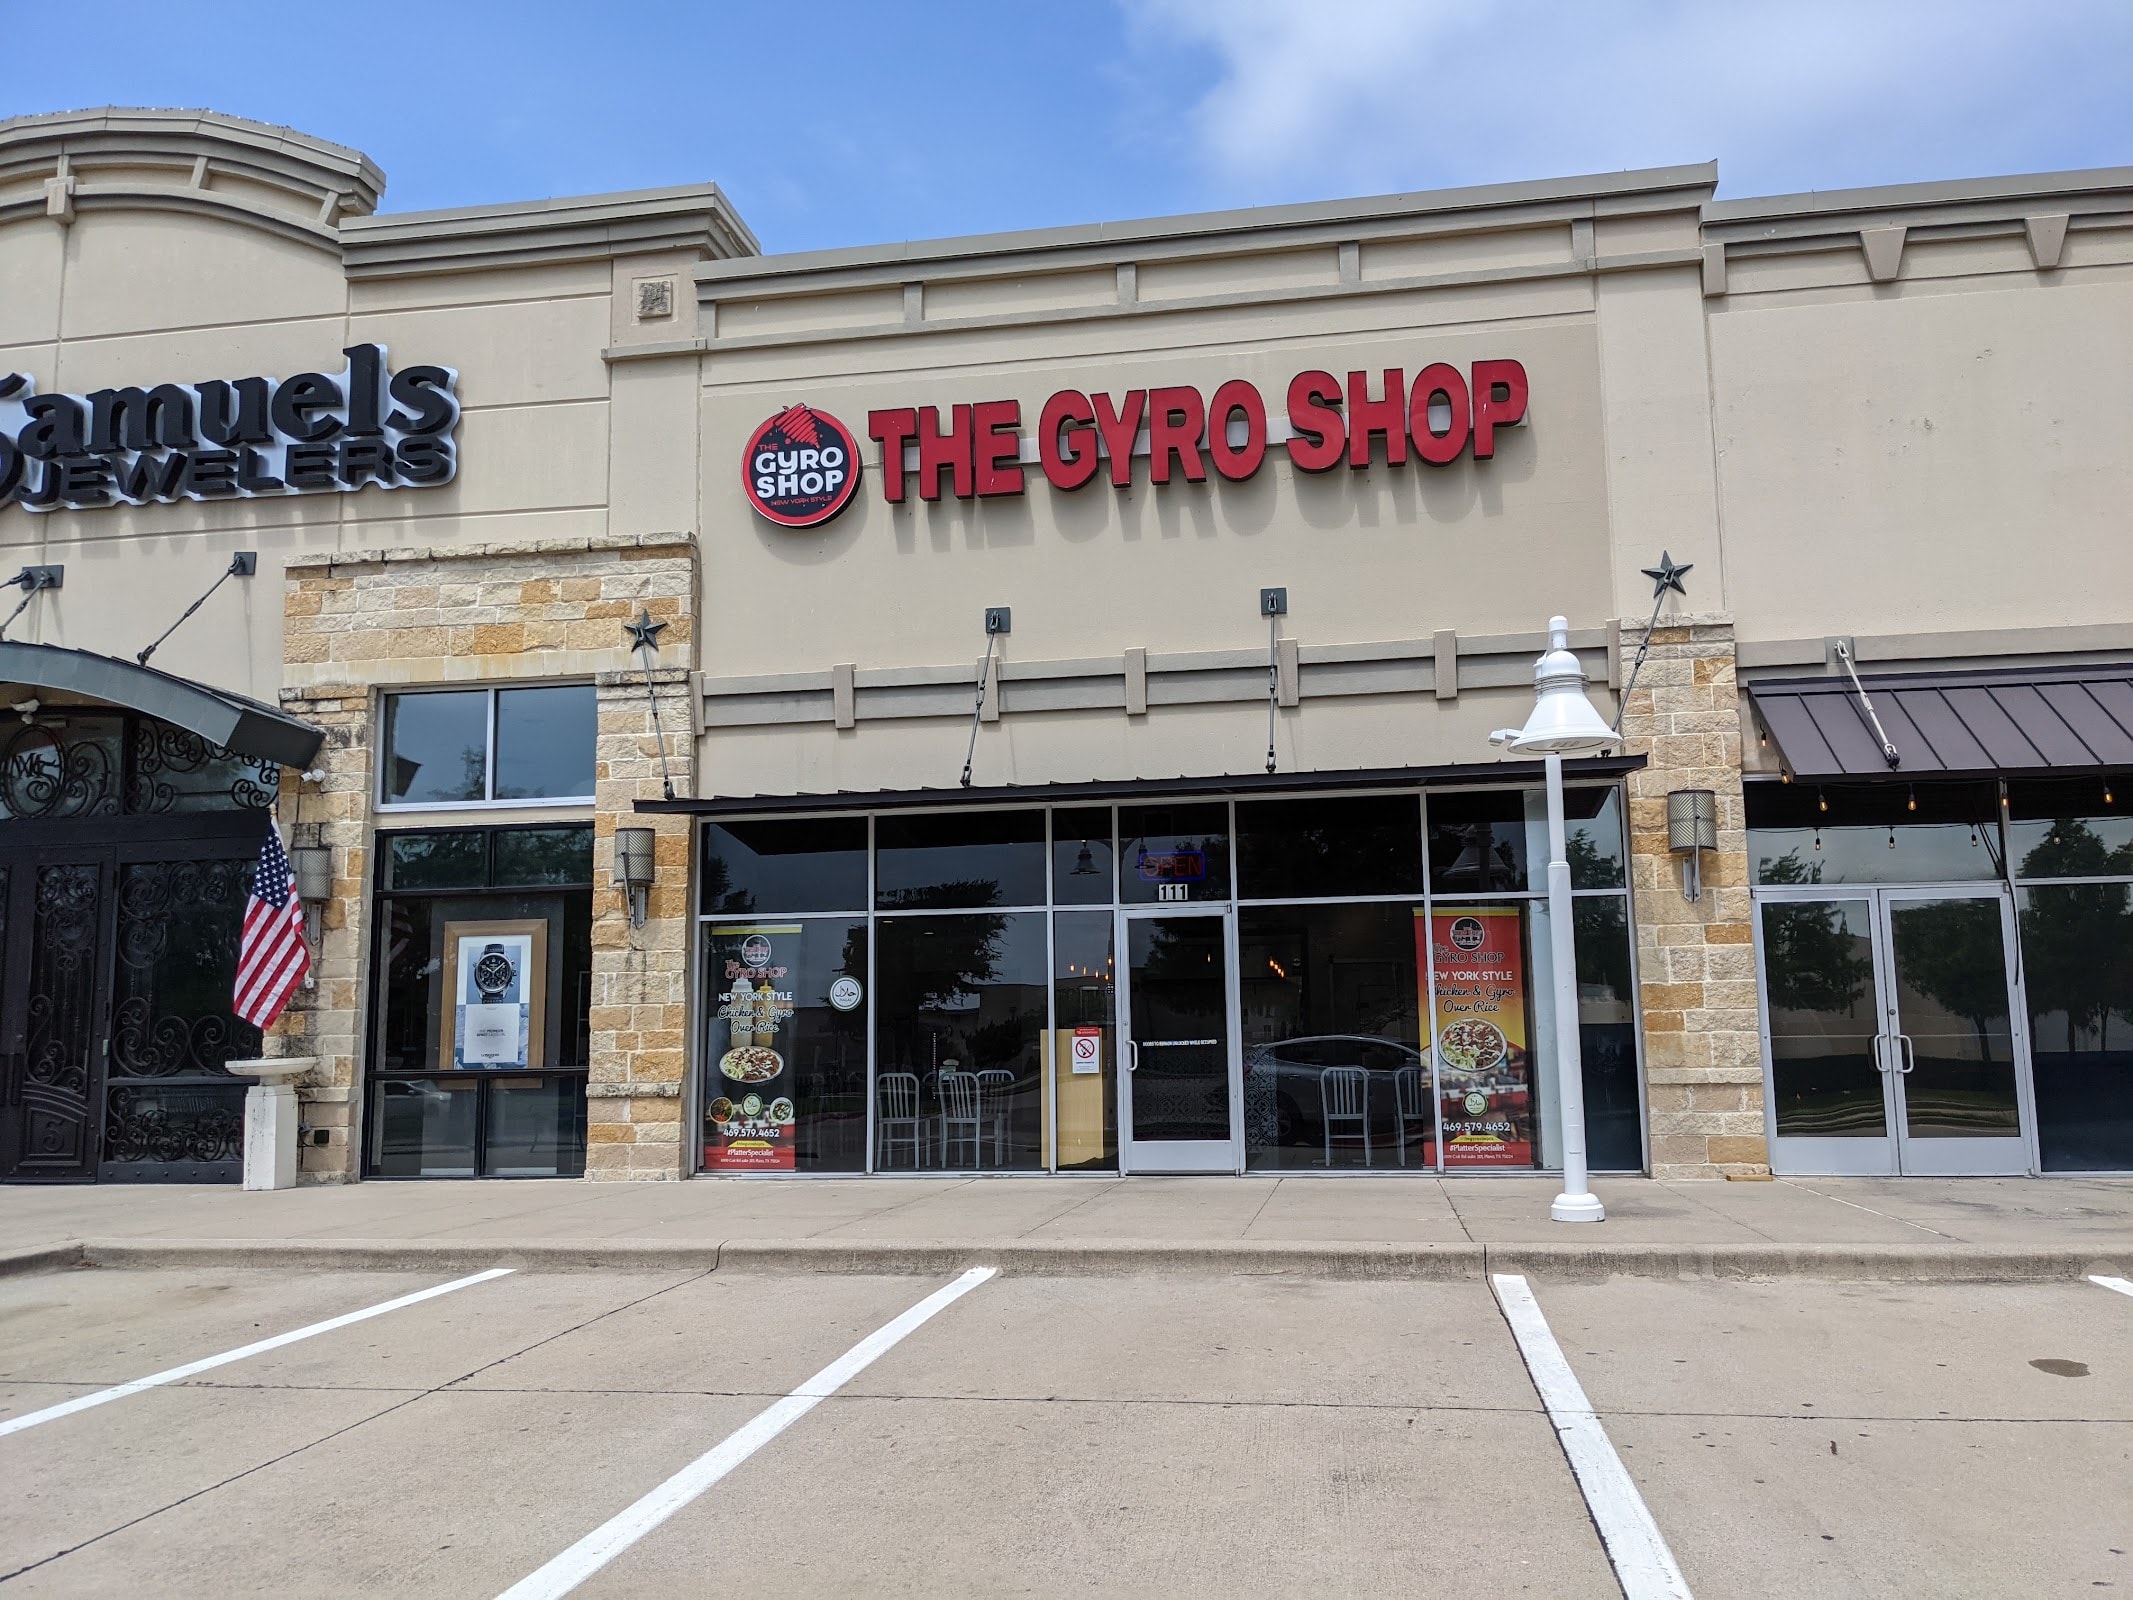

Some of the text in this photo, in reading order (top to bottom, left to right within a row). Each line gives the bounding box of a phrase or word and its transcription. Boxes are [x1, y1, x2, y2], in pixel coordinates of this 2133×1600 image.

[868, 358, 1529, 504] THE GYRO SHOP
[758, 443, 779, 451] THE
[755, 446, 844, 475] GYRO
[14, 436, 452, 505] JEWELERS
[756, 469, 844, 499] SHOP
[810, 495, 833, 503] STYLE
[1142, 856, 1203, 877] OPEN
[1160, 884, 1186, 900] 111
[1433, 951, 1505, 963] GYRO SHOP
[725, 966, 788, 979] GYRO SHOP
[1451, 971, 1480, 980] YORK
[1482, 970, 1513, 981] STYLE
[718, 992, 793, 1001] NEW YORK STYLE
[1472, 984, 1481, 996] &
[1485, 983, 1515, 1001] Gyro
[718, 1004, 756, 1019] Chicken
[768, 1004, 795, 1022] Gyro
[1443, 999, 1499, 1014] Over Rice
[731, 1019, 780, 1034] Over Rice
[723, 1128, 780, 1138] 469.579.4652
[1443, 1122, 1511, 1132] 469.579.4652
[727, 1148, 774, 1158] #PlatterSpecialist
[1449, 1143, 1506, 1153] #PlatterSpecialist
